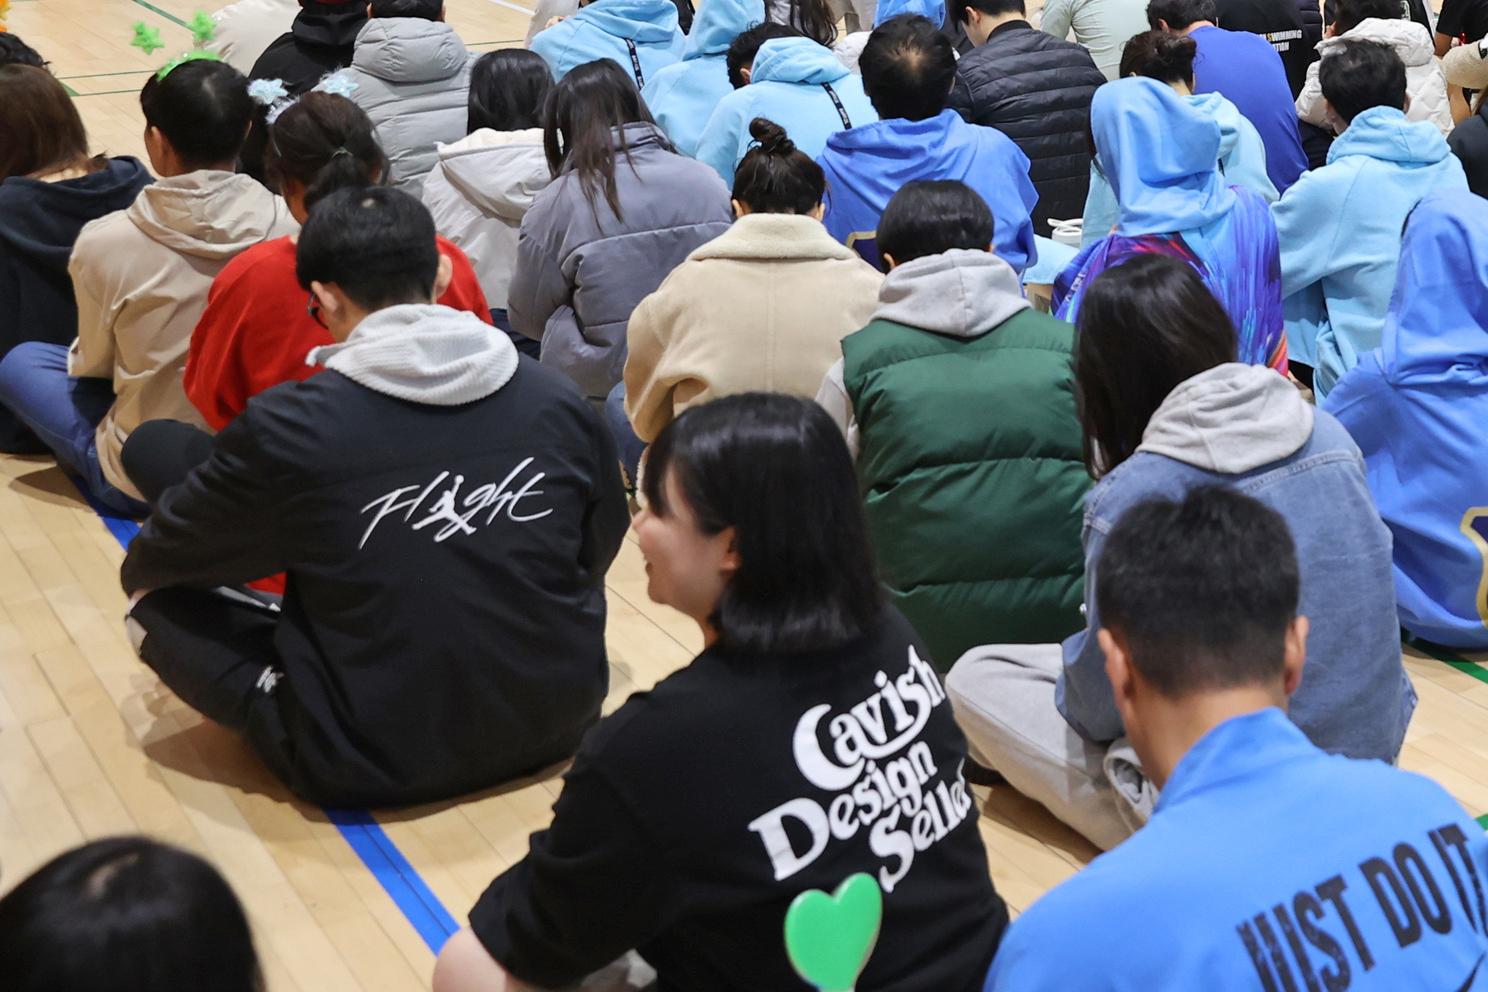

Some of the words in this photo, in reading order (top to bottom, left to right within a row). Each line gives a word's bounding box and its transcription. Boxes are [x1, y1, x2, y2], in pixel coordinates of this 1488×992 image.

[792, 644, 947, 792] Cavish
[747, 740, 939, 882] Design
[1358, 840, 1453, 949] DO
